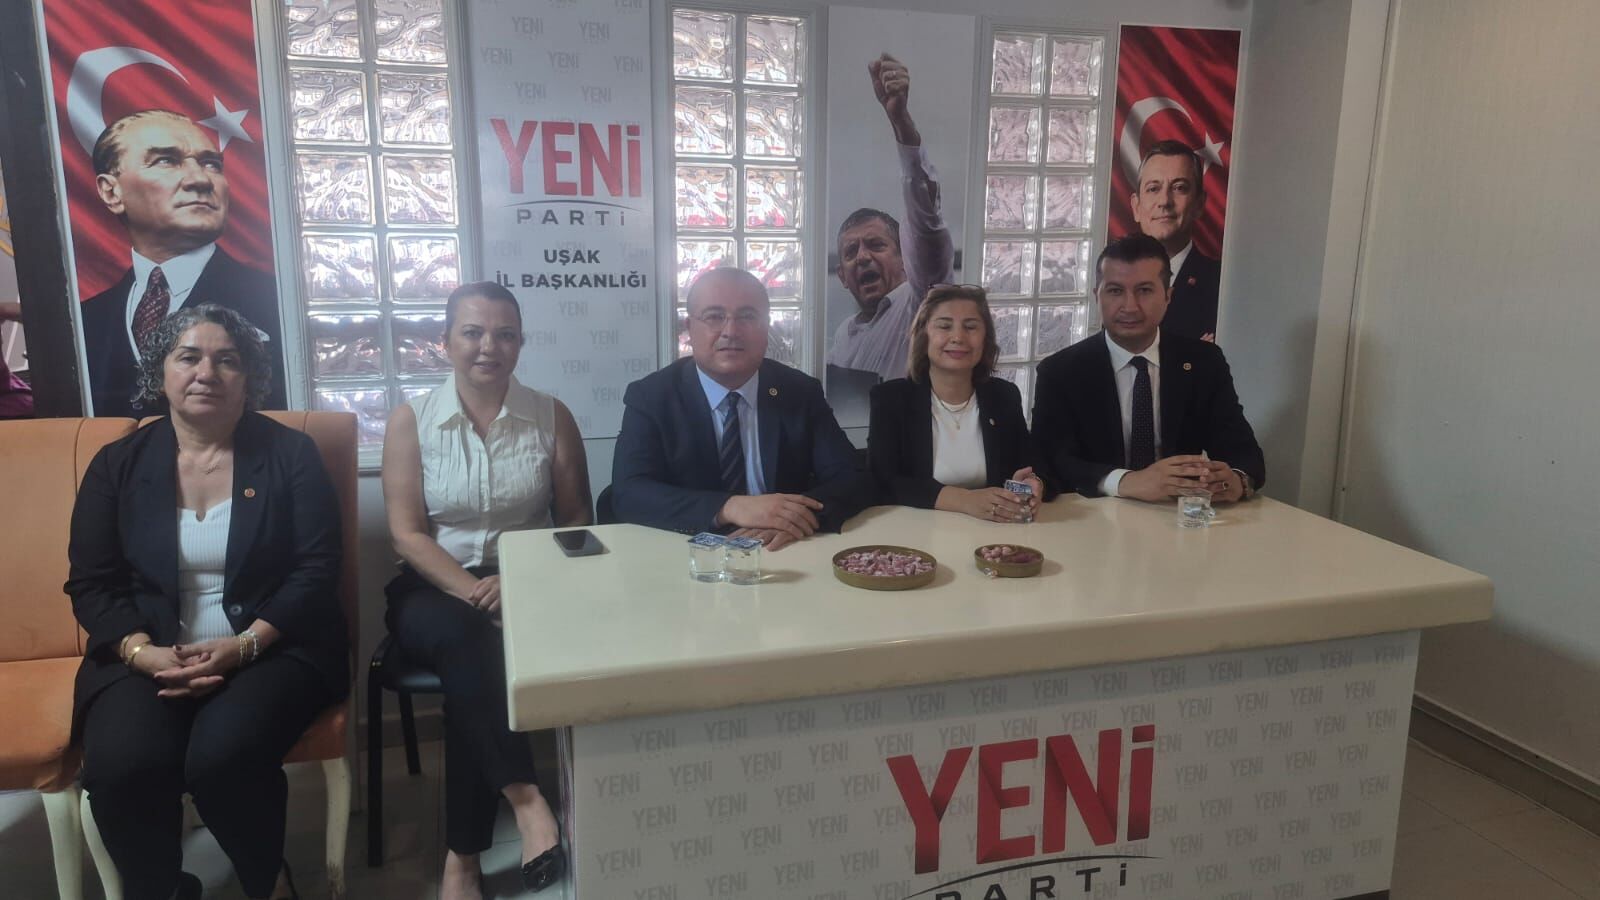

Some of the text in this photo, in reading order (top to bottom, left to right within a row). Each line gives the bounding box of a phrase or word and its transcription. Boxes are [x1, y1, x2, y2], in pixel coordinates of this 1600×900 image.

[543, 249, 601, 266] UŞAK
[496, 270, 647, 290] İL BAŞKANLIĞI
